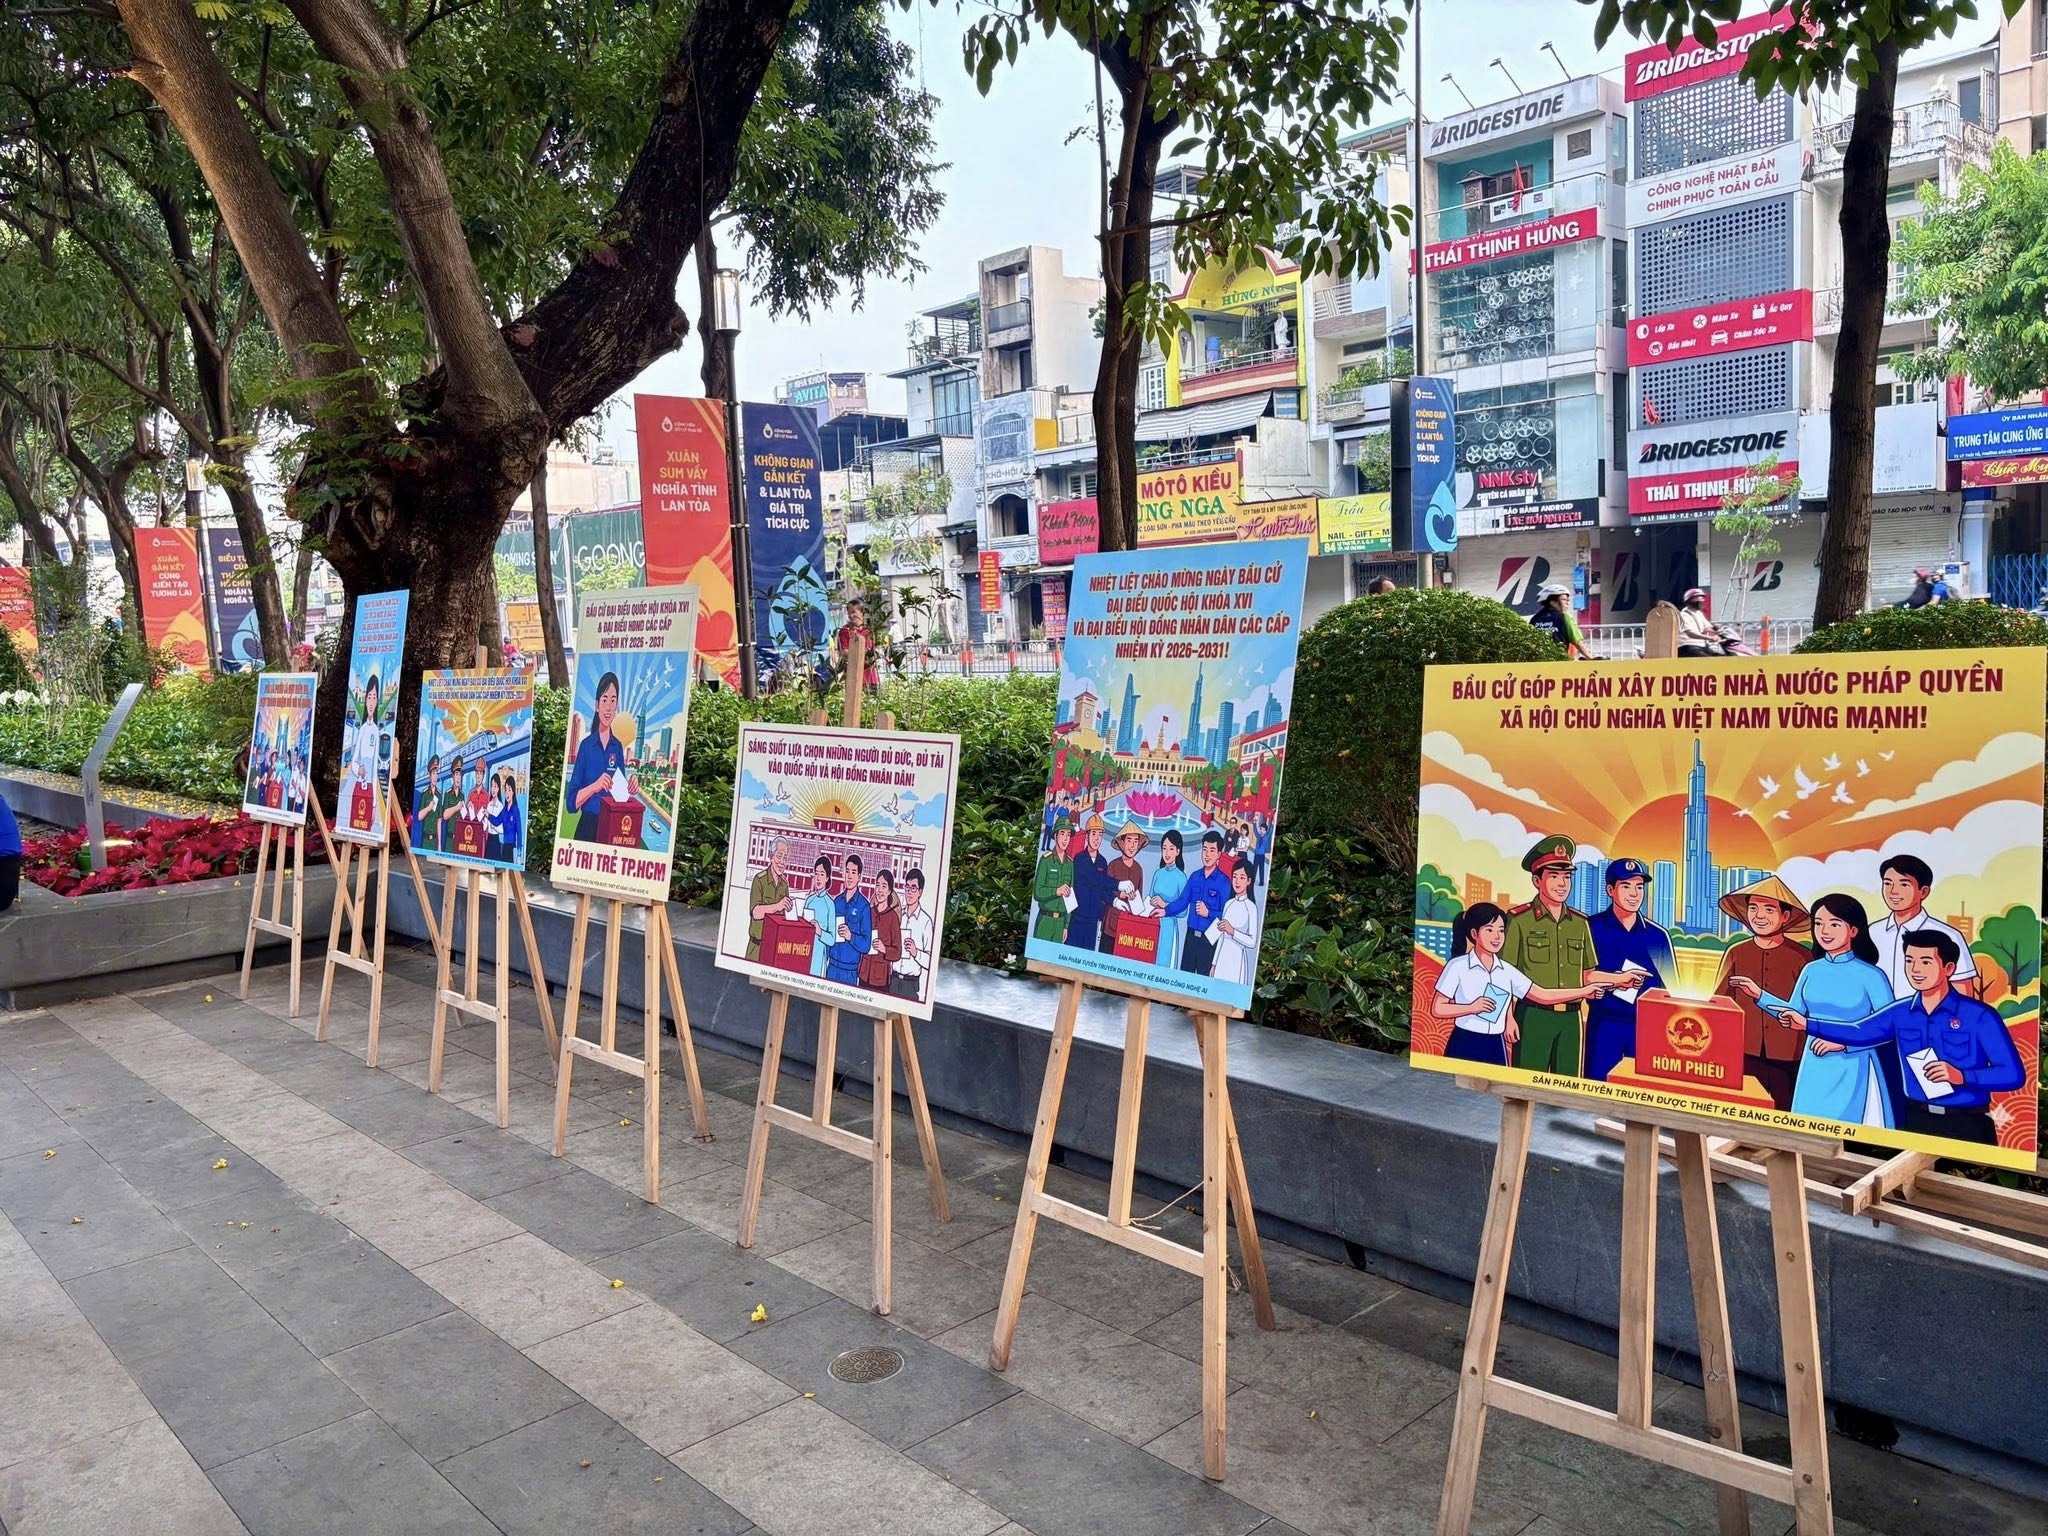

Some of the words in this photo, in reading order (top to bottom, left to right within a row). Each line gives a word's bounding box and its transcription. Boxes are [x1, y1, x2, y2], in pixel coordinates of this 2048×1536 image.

[1431, 94, 1564, 148] BRIDGESTONE
[1648, 182, 1681, 197] CÔNG
[1685, 171, 1715, 189] NGHỆ
[1717, 165, 1747, 182] NHẬT
[1751, 158, 1775, 173] BẢN
[1647, 197, 1681, 213] CHINH
[1684, 188, 1715, 206] PHỤC
[1719, 179, 1750, 196] TOÀN
[1754, 171, 1780, 187] CẦU
[1424, 242, 1463, 269] THÁI
[1467, 233, 1521, 260] THỊNH
[1526, 220, 1581, 249] HƯNG
[2012, 414, 2026, 422] BAN
[1639, 430, 1789, 464] BRIDGESTONE
[1953, 433, 1982, 449] TRUNG
[1983, 429, 2000, 446] TÂM
[2001, 429, 2024, 444] CUNG
[2026, 425, 2043, 442] ỨNG
[667, 449, 699, 463] XUÂN
[754, 454, 789, 468] KHÔNG
[790, 457, 814, 470] GIAN
[659, 467, 684, 478] SUM
[764, 467, 785, 483] GẮN
[787, 470, 806, 484] KẾT
[1141, 473, 1187, 499] MÔTÔ
[1193, 467, 1232, 493] KIỀU
[652, 481, 688, 495] NGHĨA
[691, 482, 717, 496] TÌNH
[759, 486, 767, 498] &
[769, 487, 790, 499] LAN
[792, 485, 812, 500] TỎA
[1645, 481, 1680, 503] THÁI
[1683, 478, 1730, 501] THỊNH
[661, 500, 685, 511] LAN
[688, 497, 711, 512] TỎA
[769, 500, 788, 514] GIÁ
[788, 502, 805, 518] TRỊ
[1180, 496, 1226, 518] NGA
[1541, 503, 1574, 512] ANDROID
[765, 516, 789, 530] TÍCH
[790, 518, 810, 532] CỰC
[1328, 532, 1347, 540] NAIL
[1355, 529, 1374, 539] GIFT
[577, 540, 646, 572] GOONG
[1324, 542, 1337, 553] 84
[1089, 572, 1118, 595] NHIỆT
[1119, 570, 1140, 594] LIỆT
[1141, 569, 1169, 590] CHÀO
[1170, 567, 1203, 589] MỪNG
[1205, 565, 1236, 587] NGÀY
[1238, 561, 1262, 585] BẦU
[1264, 560, 1283, 584] CỬ
[660, 599, 677, 614] KHÓA
[678, 601, 690, 614] XVI
[1107, 597, 1123, 618] ĐẠI
[1125, 591, 1149, 613] BIỂU
[1150, 590, 1179, 614] QUỐC
[1180, 591, 1199, 615] HỘI
[1200, 589, 1231, 611] KHÓA
[1233, 592, 1253, 610] XVI
[1073, 618, 1085, 636] VÀ
[1087, 621, 1103, 639] ĐẠI
[1105, 613, 1128, 636] BIỂU
[1129, 616, 1147, 639] HỘI
[1149, 614, 1178, 636] ĐỒNG
[1179, 614, 1212, 635] NHÂN
[1213, 614, 1238, 635] DÂN
[1239, 613, 1263, 634] CÁC
[1265, 610, 1291, 634] CẤP
[629, 637, 644, 649] 2026
[649, 636, 665, 648] 2031
[1115, 639, 1149, 662] NHIỆM
[1150, 638, 1165, 659] KỲ
[1453, 673, 1486, 700] BẦU
[1492, 672, 1517, 700] CỬ
[1520, 674, 1556, 699] GÓP
[1561, 670, 1613, 698] PHẦN
[1618, 671, 1656, 698] XÂY
[1661, 672, 1717, 701] DỰNG
[1723, 668, 1769, 697] NHÀ
[1775, 667, 1839, 695] NƯỚC
[1846, 665, 1912, 694] PHÁP
[1919, 659, 2004, 695] QUYỀN
[1500, 705, 1523, 729] XÃ
[1529, 704, 1558, 733] HỘI
[1564, 701, 1601, 729] CHỦ
[1607, 702, 1667, 729] NGHĨA
[1672, 702, 1715, 734] VIỆT
[1720, 706, 1771, 729] NAM
[1777, 701, 1839, 729] VỮNG
[1846, 705, 1928, 735] MẠNH!
[748, 738, 767, 755] SÁNG
[768, 740, 788, 756] SUỐT
[788, 742, 802, 759] LỰA
[803, 743, 825, 760] CHỌN
[826, 743, 853, 762] NHỮNG
[854, 745, 879, 763] NGƯỜI
[881, 745, 894, 765] ĐỦ
[894, 748, 914, 768] ĐỨC,
[916, 748, 930, 768] ĐỦ
[930, 750, 944, 769] TÀI
[768, 759, 783, 774] VÀO
[783, 760, 804, 777] QUỐC
[804, 763, 819, 780] HỘI
[819, 763, 830, 778] VÀ
[831, 765, 845, 783] HỘI
[845, 765, 868, 782] ĐỒNG
[869, 769, 893, 786] NHÂN
[894, 771, 916, 787] DÂN!
[557, 842, 574, 867] CỬ
[576, 850, 593, 870] TRI
[596, 849, 618, 874] TRẺ
[621, 856, 667, 882] TP.HCM
[777, 940, 792, 955] HÒM
[792, 940, 811, 957] PHIẾU
[1118, 933, 1134, 948] HÒM
[1134, 935, 1155, 953] PHIẾU
[1651, 1053, 1683, 1073] HÒM
[1684, 1059, 1725, 1080] PHIẾU
[1532, 1073, 1551, 1087] SẢN
[1552, 1077, 1580, 1092] PHẨM
[1582, 1081, 1614, 1096] TUYÊN
[1615, 1087, 1654, 1104] TRUYỀN
[1656, 1095, 1687, 1111] ĐƯỢC
[1690, 1100, 1721, 1115] THIẾT
[1721, 1105, 1738, 1118] KẾ
[1739, 1108, 1771, 1123] BẰNG
[1772, 1112, 1806, 1130] CÔNG
[1808, 1118, 1842, 1137] NGHỆ
[1843, 1125, 1857, 1138] AI
